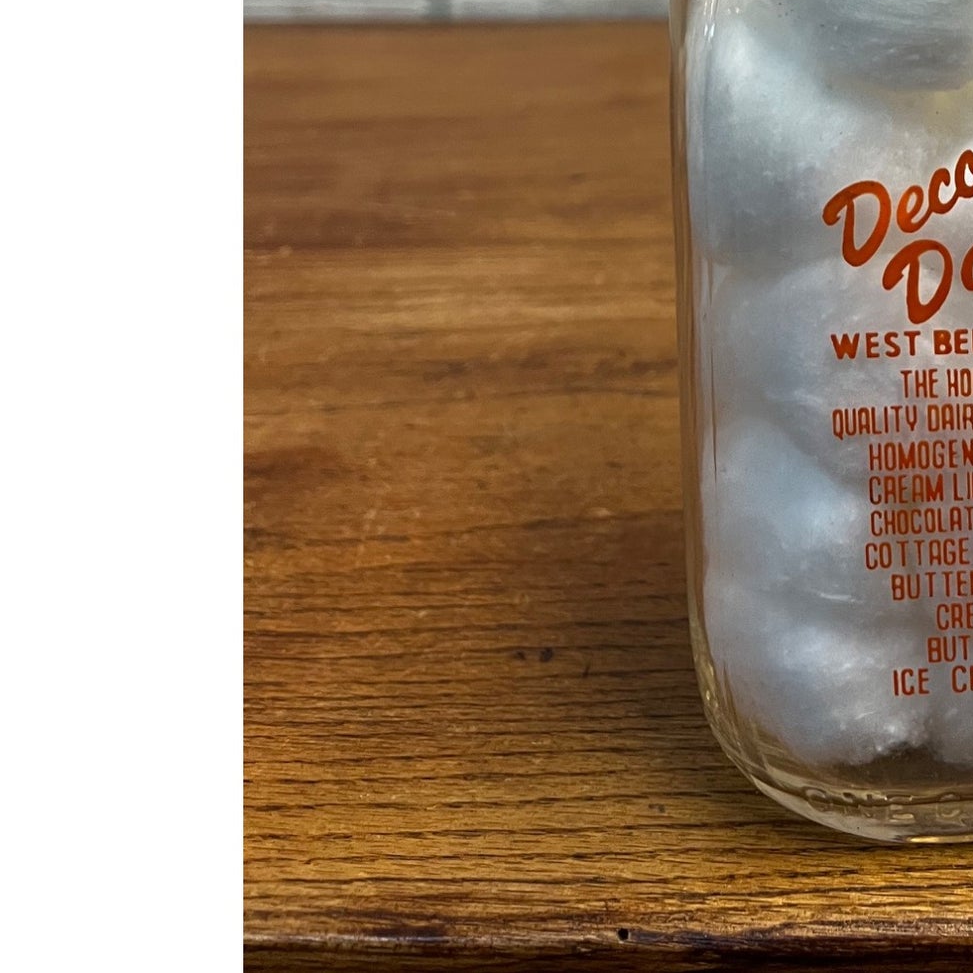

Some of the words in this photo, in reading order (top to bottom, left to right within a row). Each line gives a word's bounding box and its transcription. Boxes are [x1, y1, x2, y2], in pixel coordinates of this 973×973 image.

[831, 330, 921, 359] WEST
[901, 369, 938, 398] THE
[832, 405, 918, 440] QUALITY
[869, 473, 944, 504] CREAM
[865, 537, 969, 570] COTTAGE
[893, 668, 929, 696] ICE
